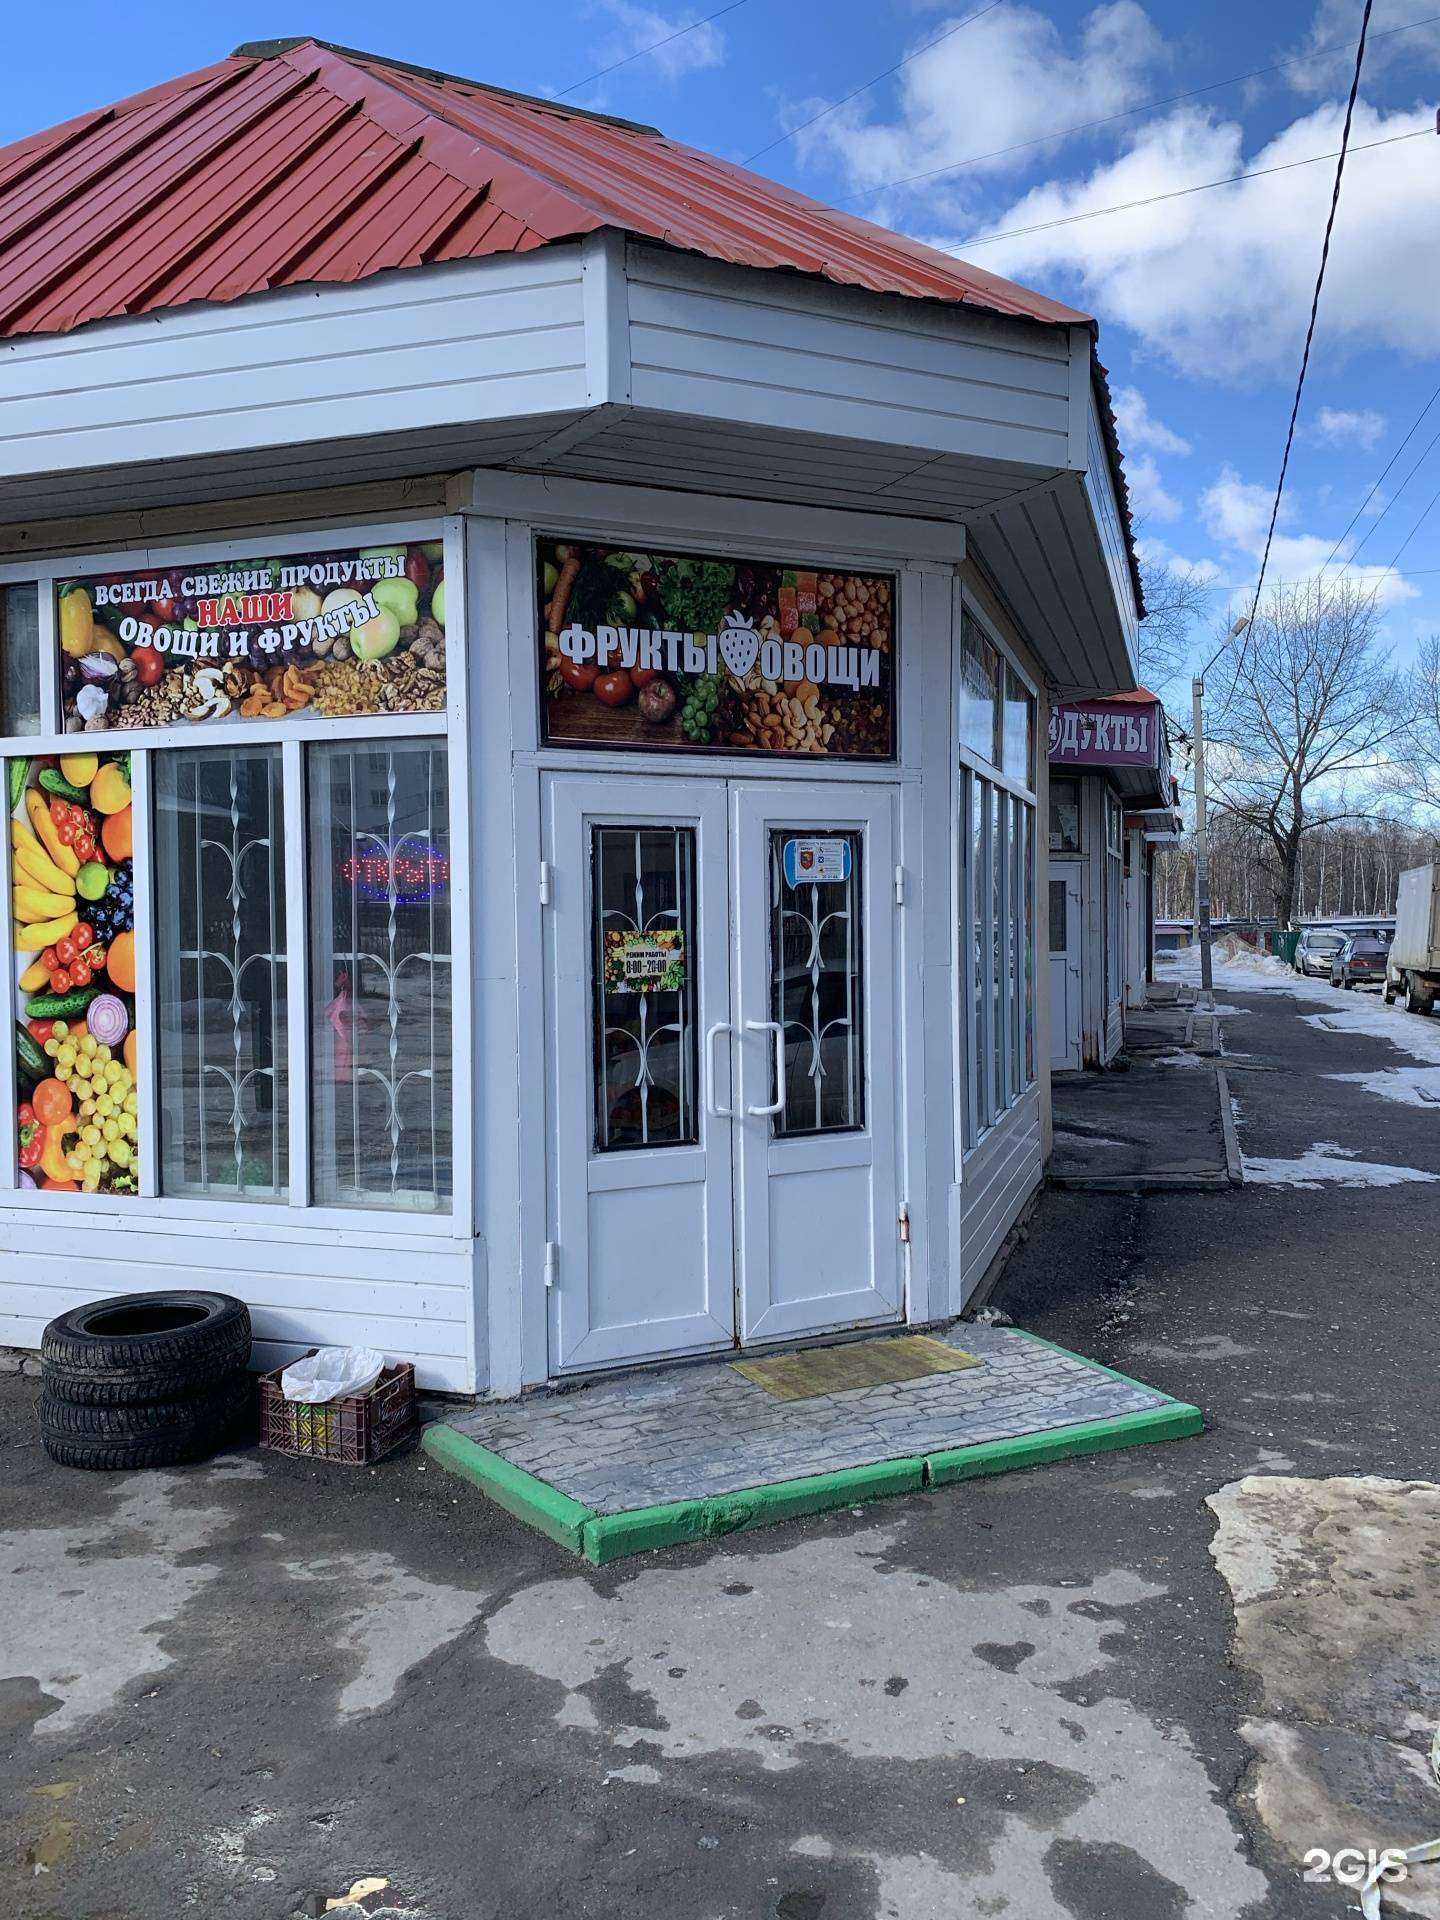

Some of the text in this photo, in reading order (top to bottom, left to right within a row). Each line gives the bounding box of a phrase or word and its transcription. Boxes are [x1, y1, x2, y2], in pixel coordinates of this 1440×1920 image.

[95, 556, 406, 605] ВСЕГДА СВЕЖИЕ ПРОДУКТЫ
[197, 592, 294, 627] НАШИ
[119, 592, 380, 661] ОВОЩИ И ФРУКТЫ
[558, 623, 880, 691] ФРУКТЫ ОВОЩИ
